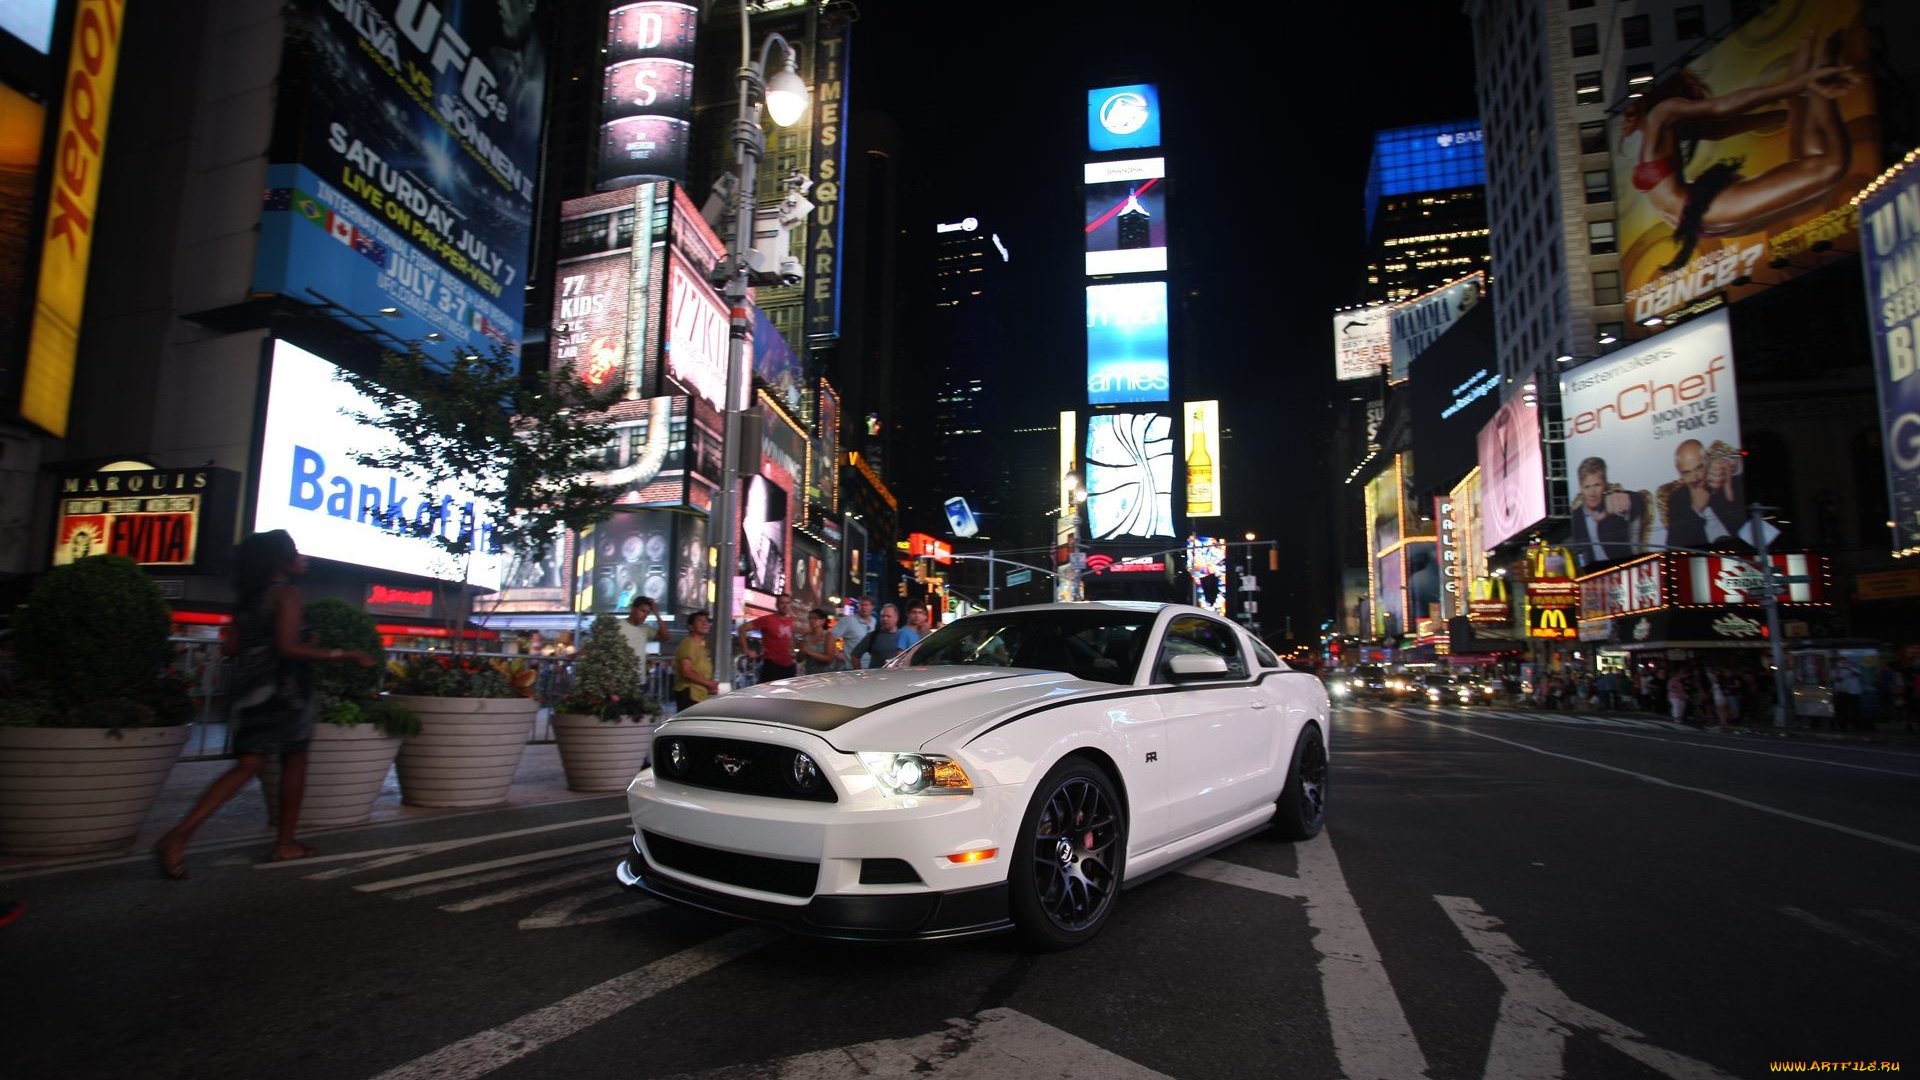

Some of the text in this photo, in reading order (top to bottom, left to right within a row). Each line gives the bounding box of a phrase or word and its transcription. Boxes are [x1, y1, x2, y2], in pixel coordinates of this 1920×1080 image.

[393, 0, 500, 119] UFC
[51, 0, 120, 262] odak
[813, 38, 843, 300] TIMES SQUARE
[327, 122, 456, 244] SATURDAY,
[455, 229, 504, 277] JULY
[504, 264, 517, 286] 7
[341, 166, 385, 210] LIVE
[384, 200, 412, 231] ON
[411, 219, 504, 299] PAY-PER-VIEW
[386, 252, 468, 322] JULY 3-7
[561, 293, 605, 319] KIDS
[562, 275, 585, 297] 77
[1393, 296, 1452, 340] MAMMA
[1651, 395, 1717, 425] MON TUE
[1676, 413, 1706, 434] FOX
[1706, 410, 1719, 425] 5
[62, 472, 208, 493] MARQUIS
[288, 444, 409, 535] Bank
[109, 514, 187, 563] EVITA
